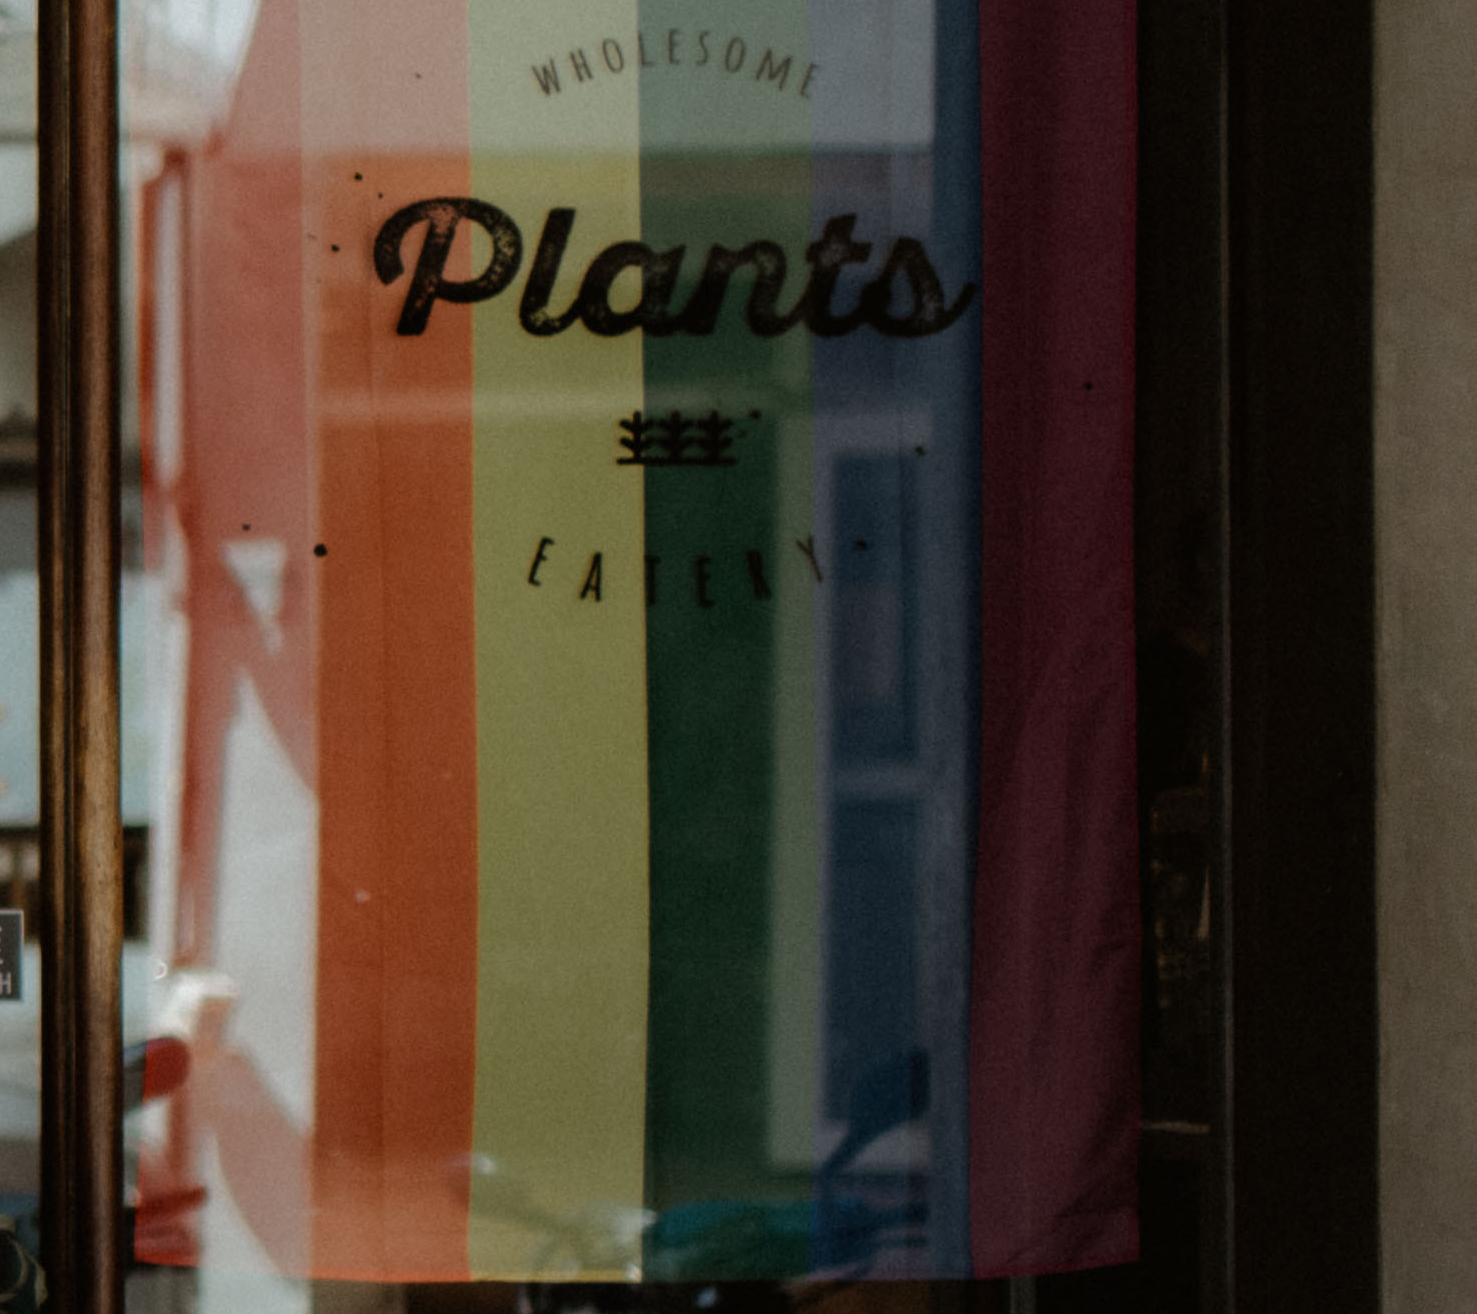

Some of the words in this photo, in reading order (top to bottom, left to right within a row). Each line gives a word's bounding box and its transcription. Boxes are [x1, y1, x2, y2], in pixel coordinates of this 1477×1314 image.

[530, 28, 821, 99] WHOLESOME
[373, 196, 981, 338] Plants
[527, 536, 825, 609] EATERY
